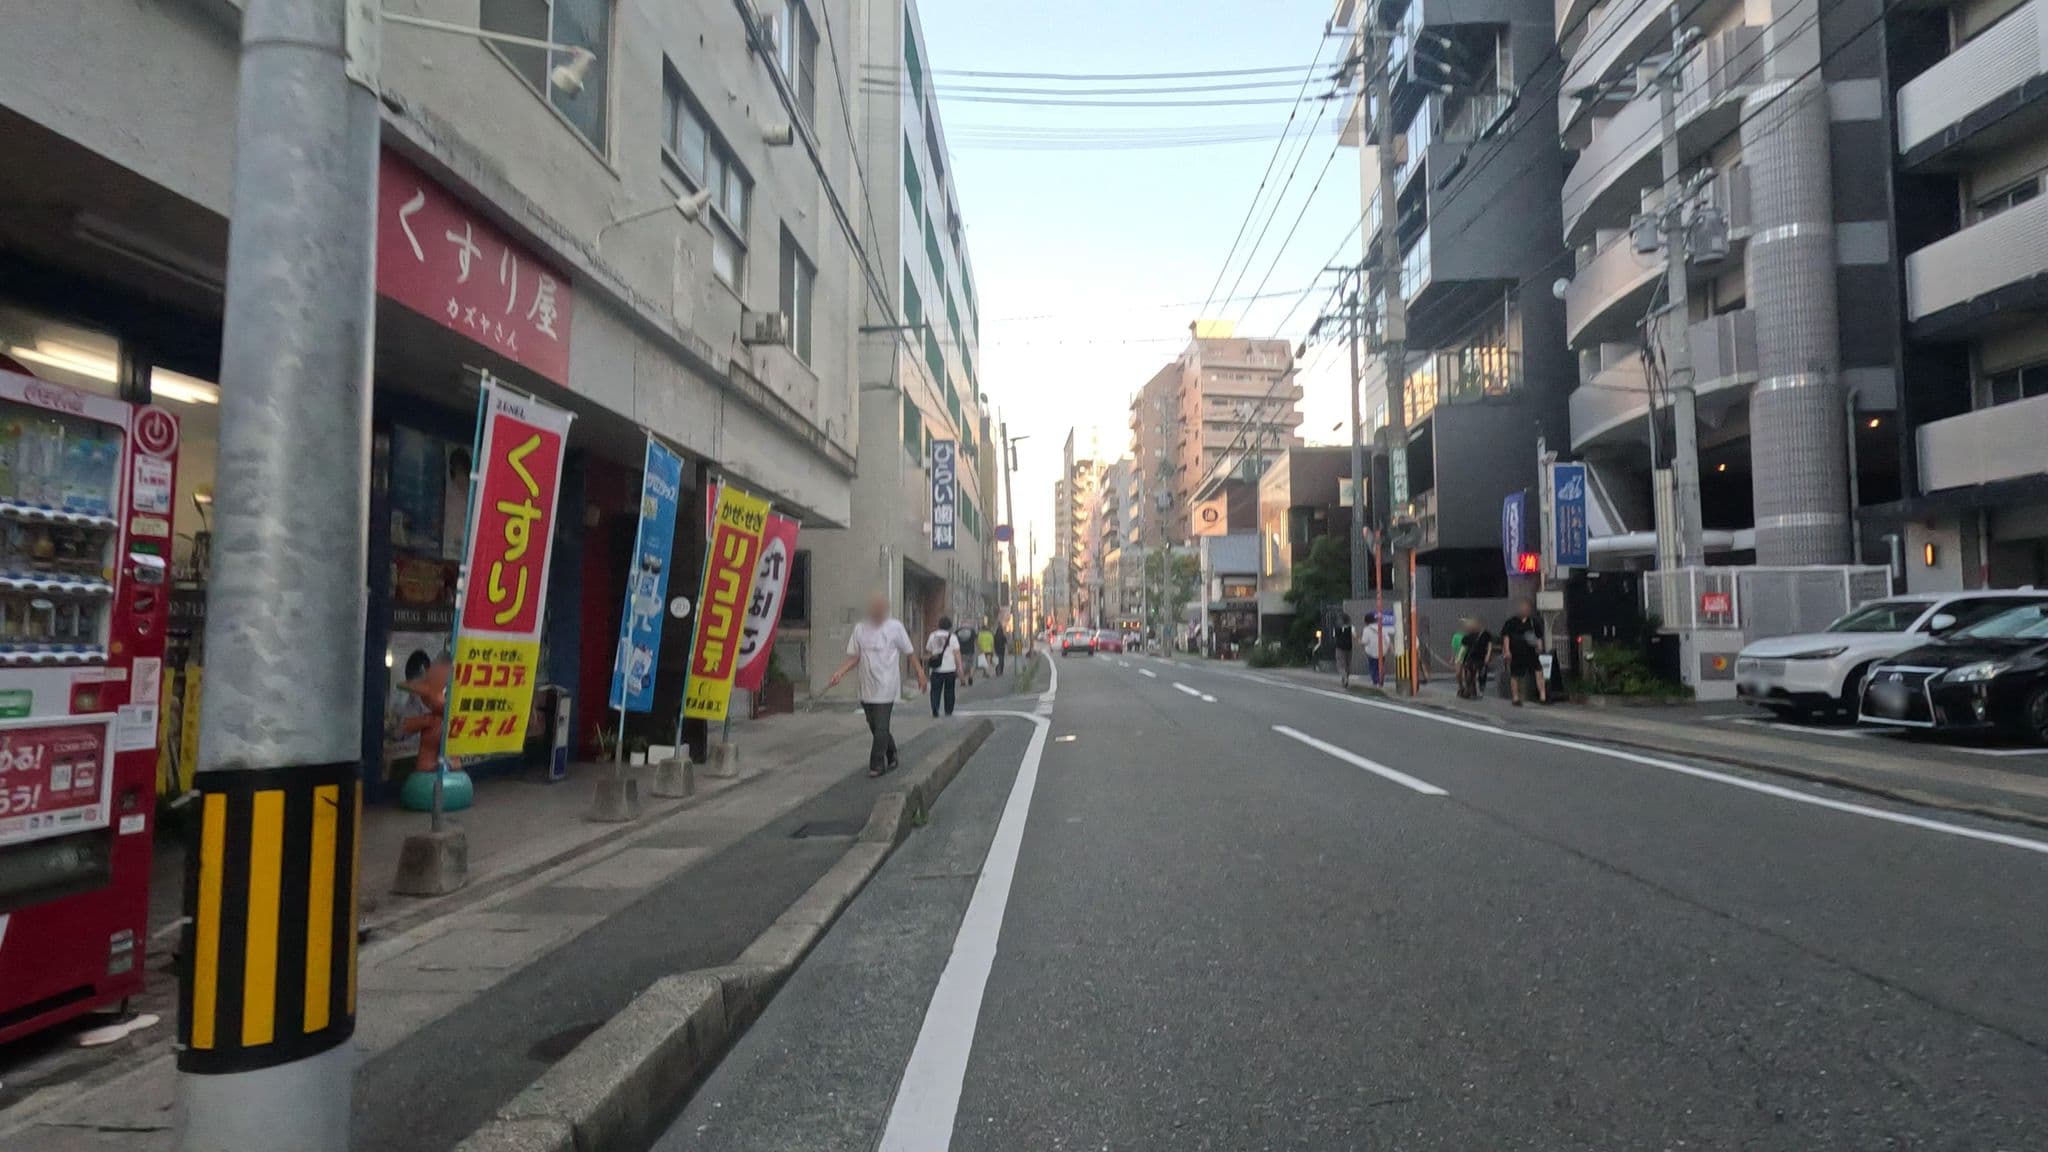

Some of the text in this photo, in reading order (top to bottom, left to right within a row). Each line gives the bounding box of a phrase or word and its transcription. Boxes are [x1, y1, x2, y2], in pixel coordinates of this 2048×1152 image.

[399, 187, 558, 342] くすり屋
[489, 434, 542, 625] くすり
[702, 533, 749, 673] リココデ
[455, 662, 527, 688] リココデ
